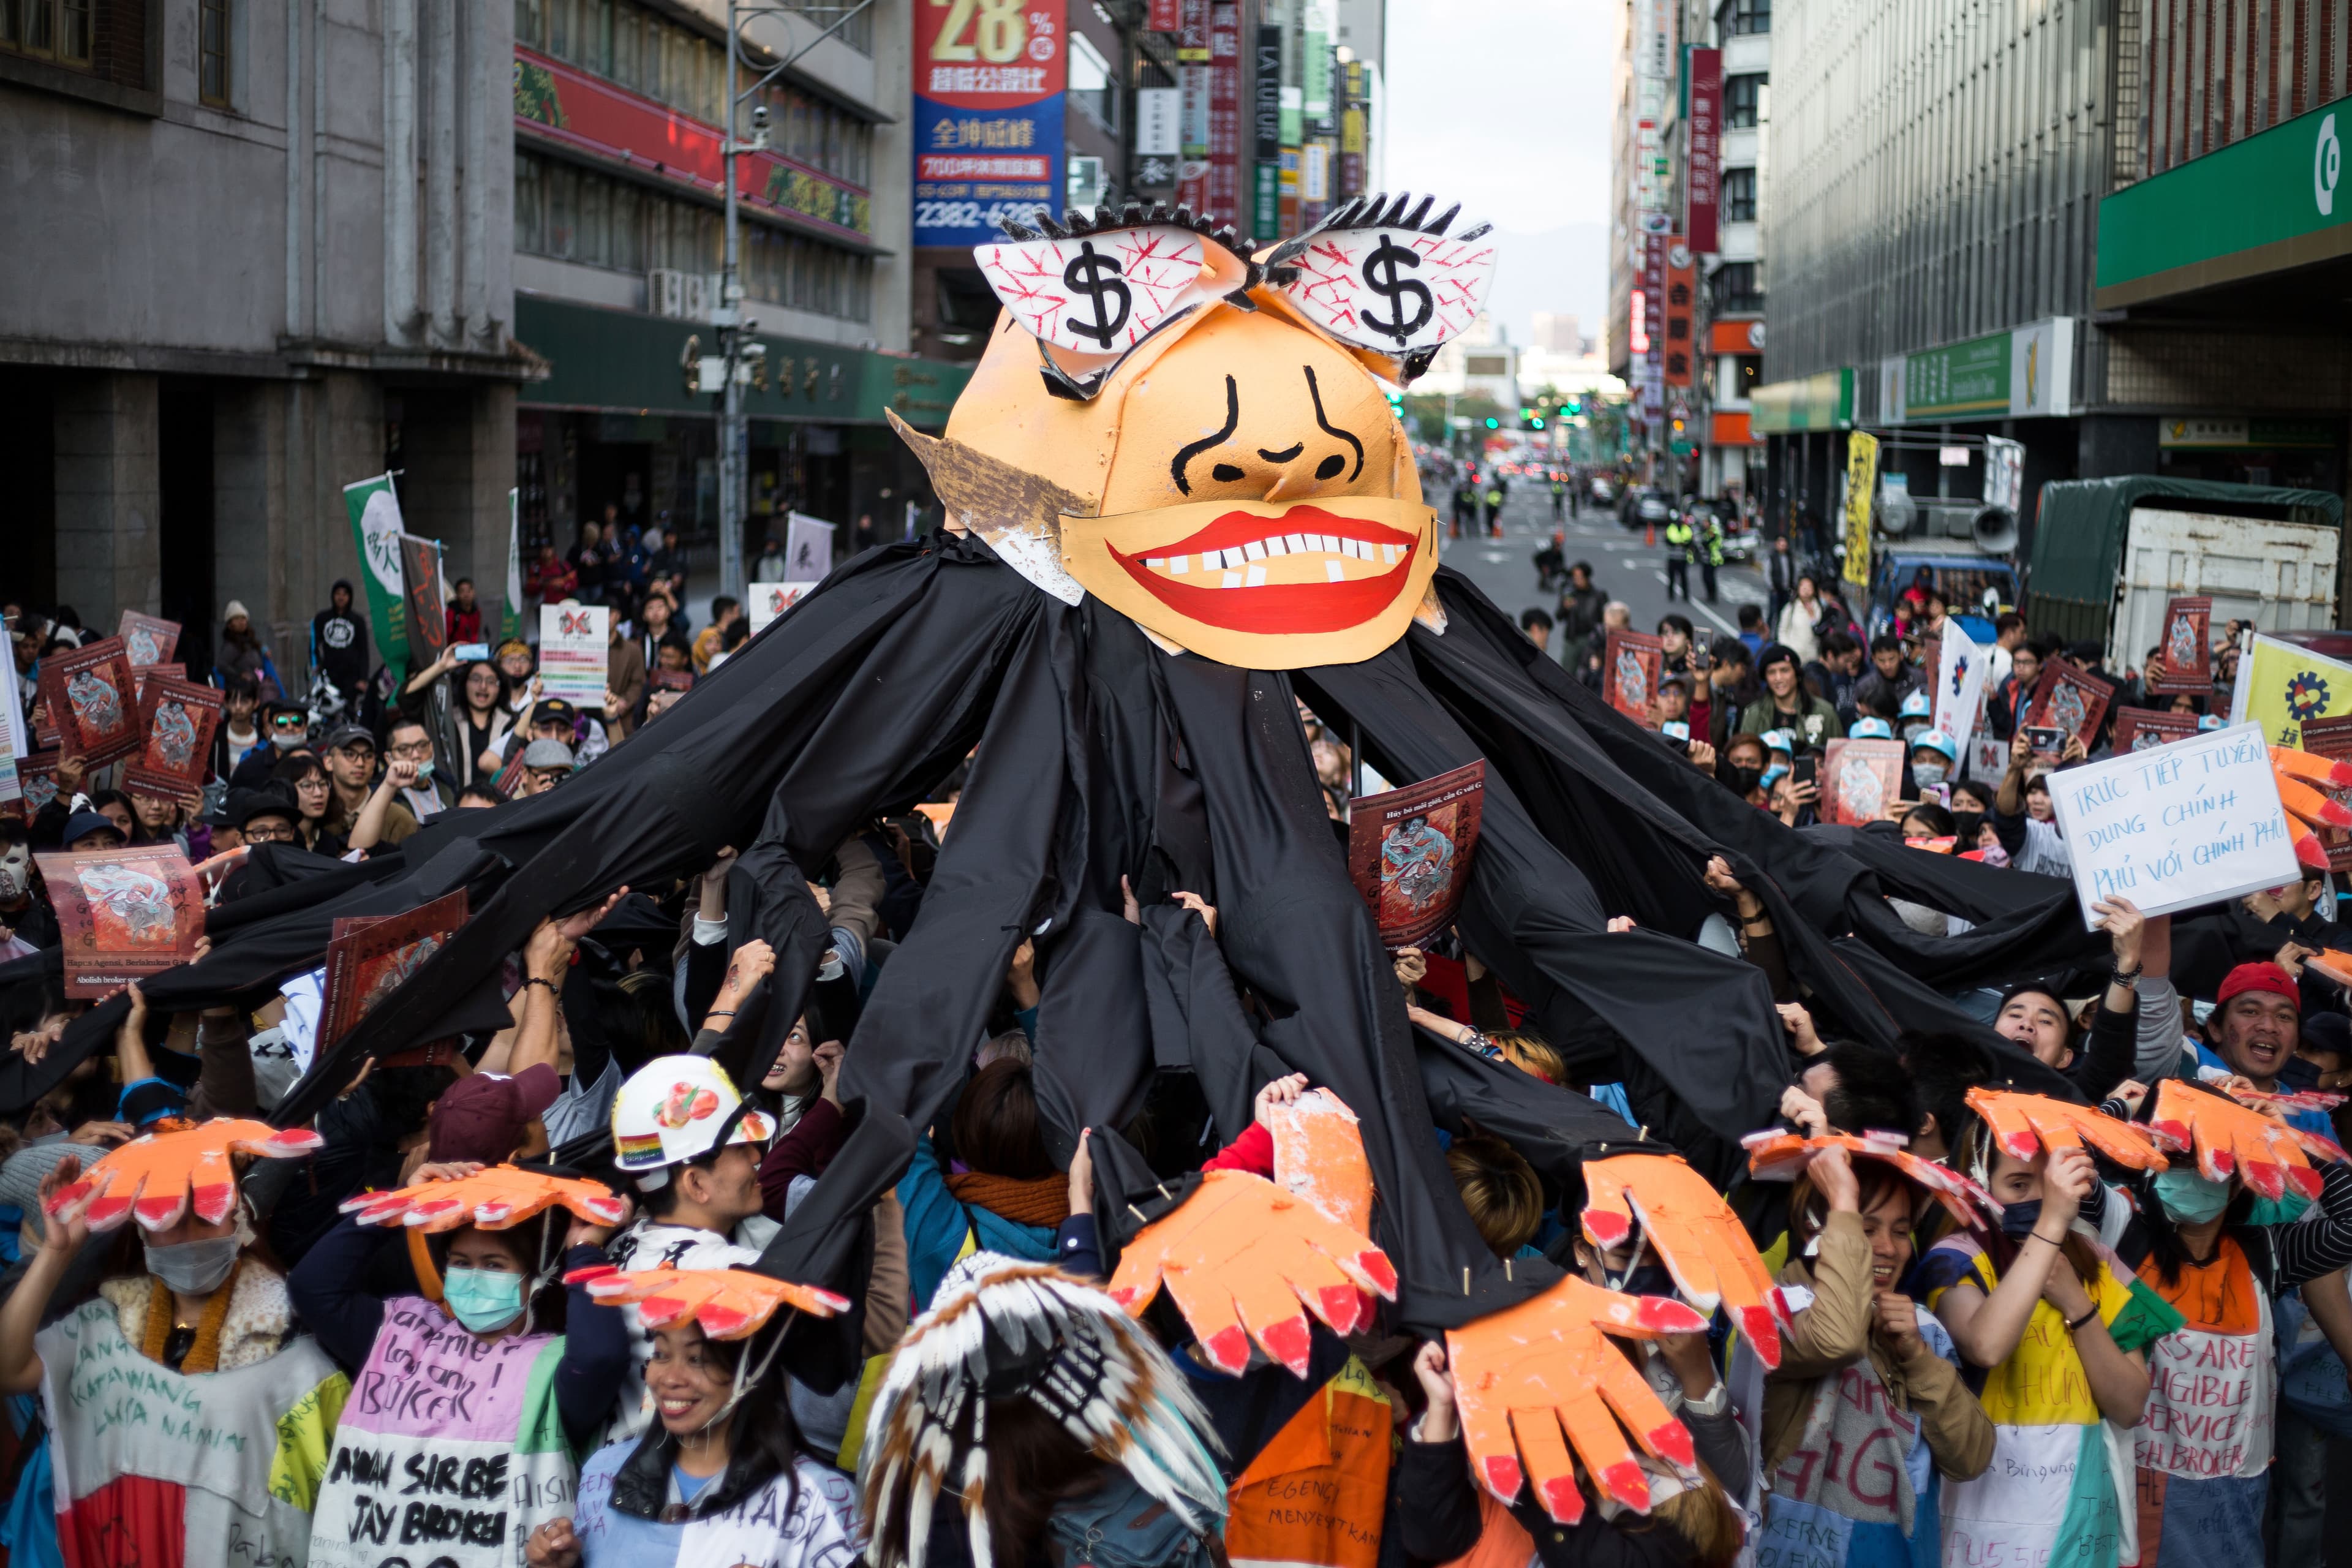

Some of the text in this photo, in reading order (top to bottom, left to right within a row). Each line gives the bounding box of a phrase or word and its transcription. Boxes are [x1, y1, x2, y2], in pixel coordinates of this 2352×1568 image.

[1414, 802, 1427, 812] môi
[2163, 783, 2239, 826] CHÍNH
[2193, 821, 2245, 866] CHÍNH
[2195, 1338, 2256, 1371] ARE
[2149, 1360, 2253, 1408] LIGIBLE
